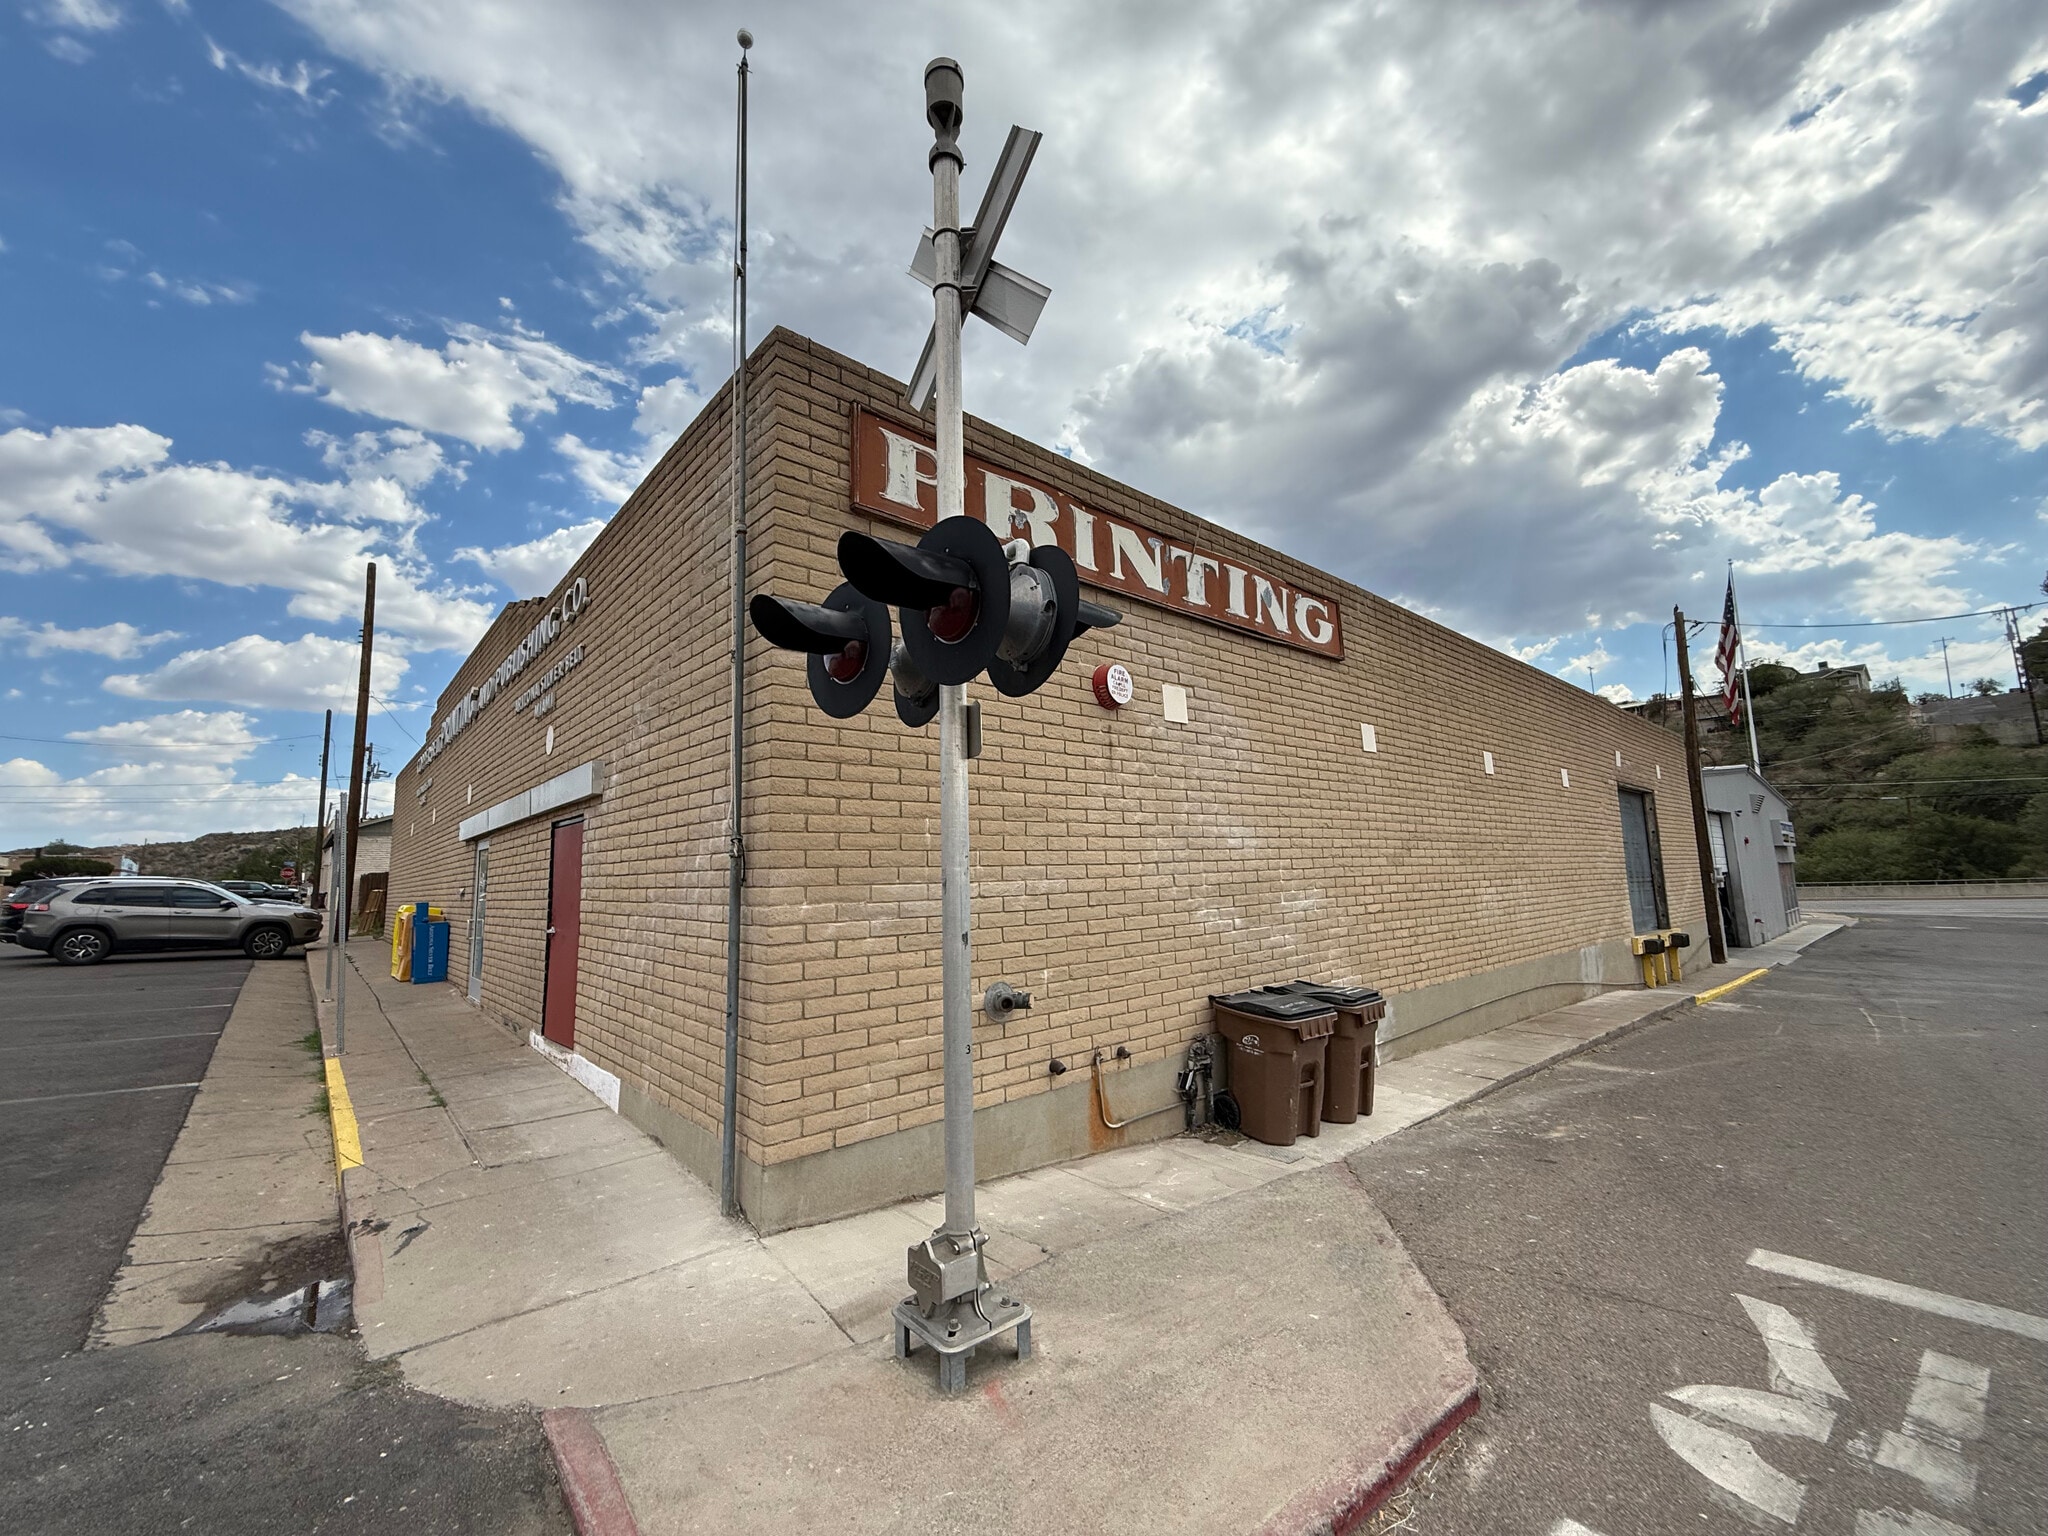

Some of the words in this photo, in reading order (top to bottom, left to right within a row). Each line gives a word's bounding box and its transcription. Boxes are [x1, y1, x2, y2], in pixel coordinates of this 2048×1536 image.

[878, 426, 1335, 645] PRINTING
[442, 686, 479, 745] PRINTING
[479, 677, 497, 709] AND
[495, 606, 561, 692] PUBLISHING
[563, 577, 592, 622] CO.
[540, 660, 566, 694] SILVER
[565, 643, 585, 675] BELT
[1111, 674, 1128, 684] ALARM
[1113, 669, 1125, 677] FIRE
